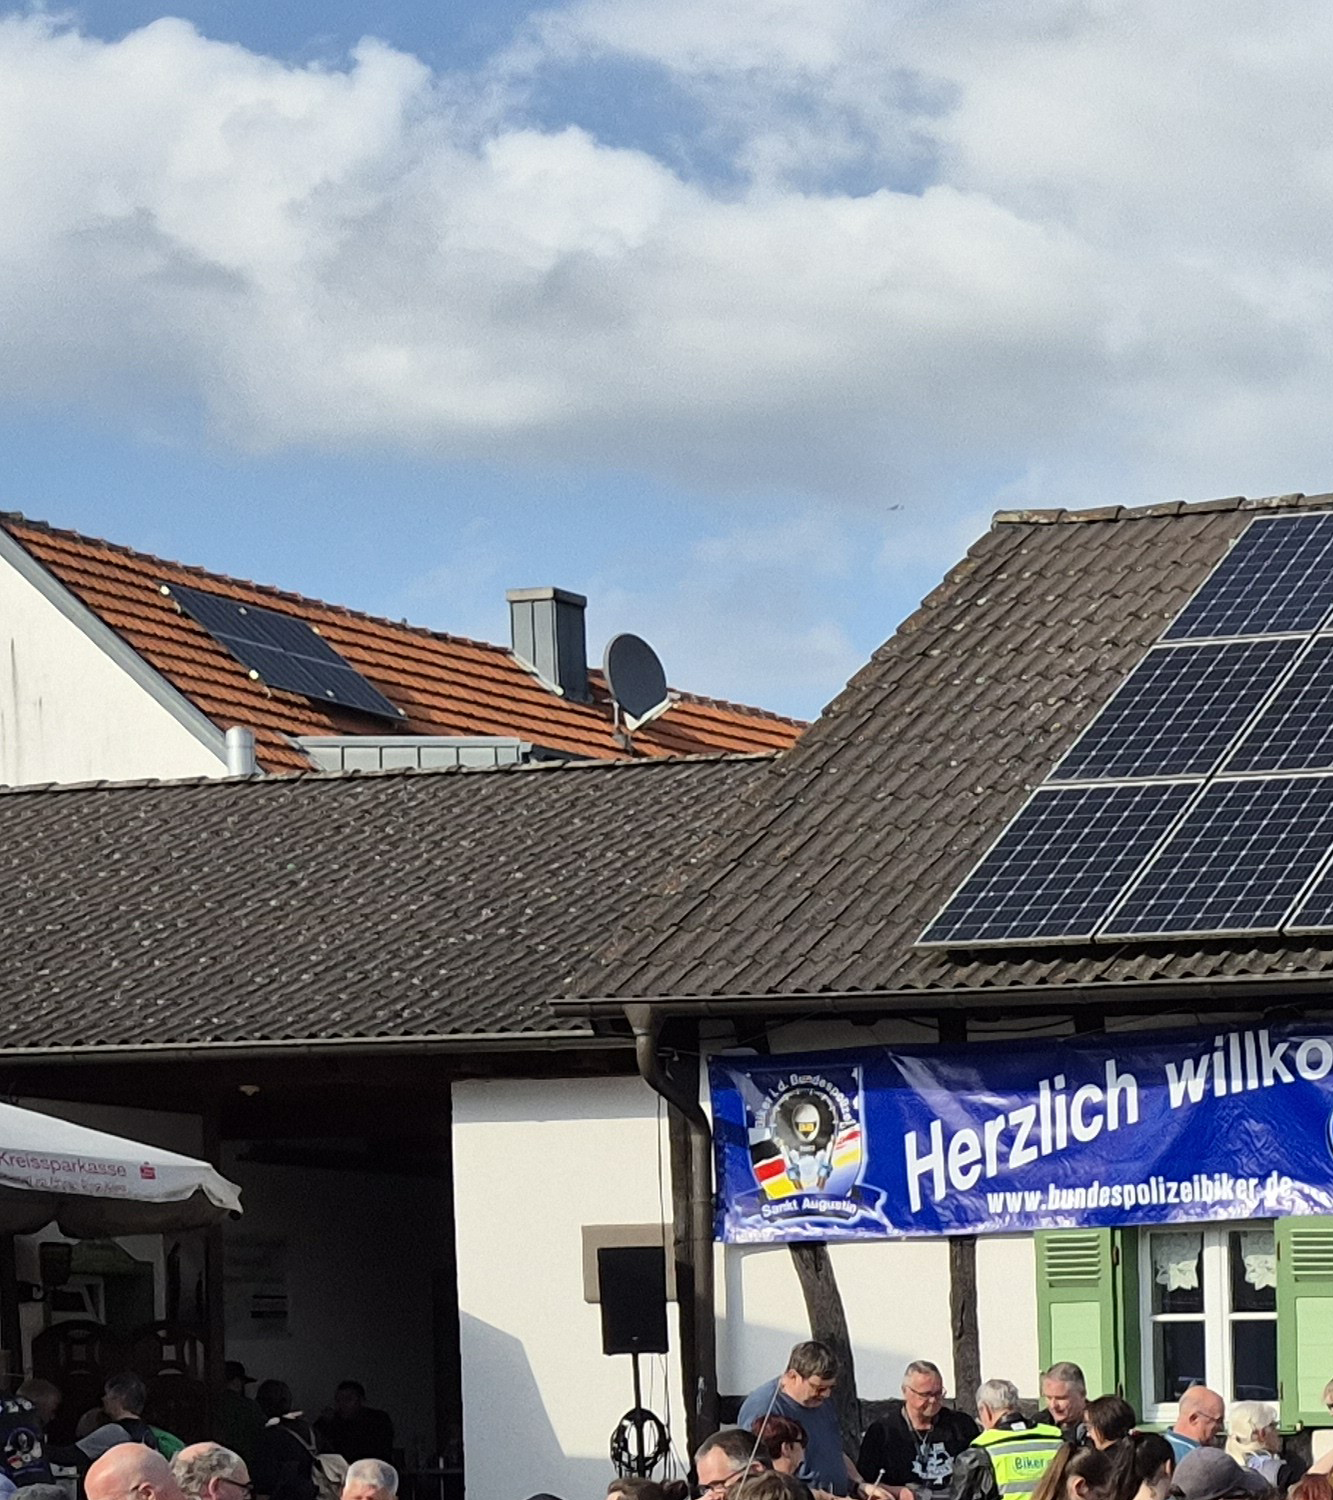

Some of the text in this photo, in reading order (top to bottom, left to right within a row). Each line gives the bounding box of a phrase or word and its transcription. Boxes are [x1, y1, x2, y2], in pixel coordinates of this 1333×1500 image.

[904, 1058, 1139, 1214] Herzlich
[761, 1197, 857, 1217] Sankt Augustin
[986, 1170, 1293, 1214] www.bundespolizeibiker.de
[1014, 1457, 1044, 1470] Biker
